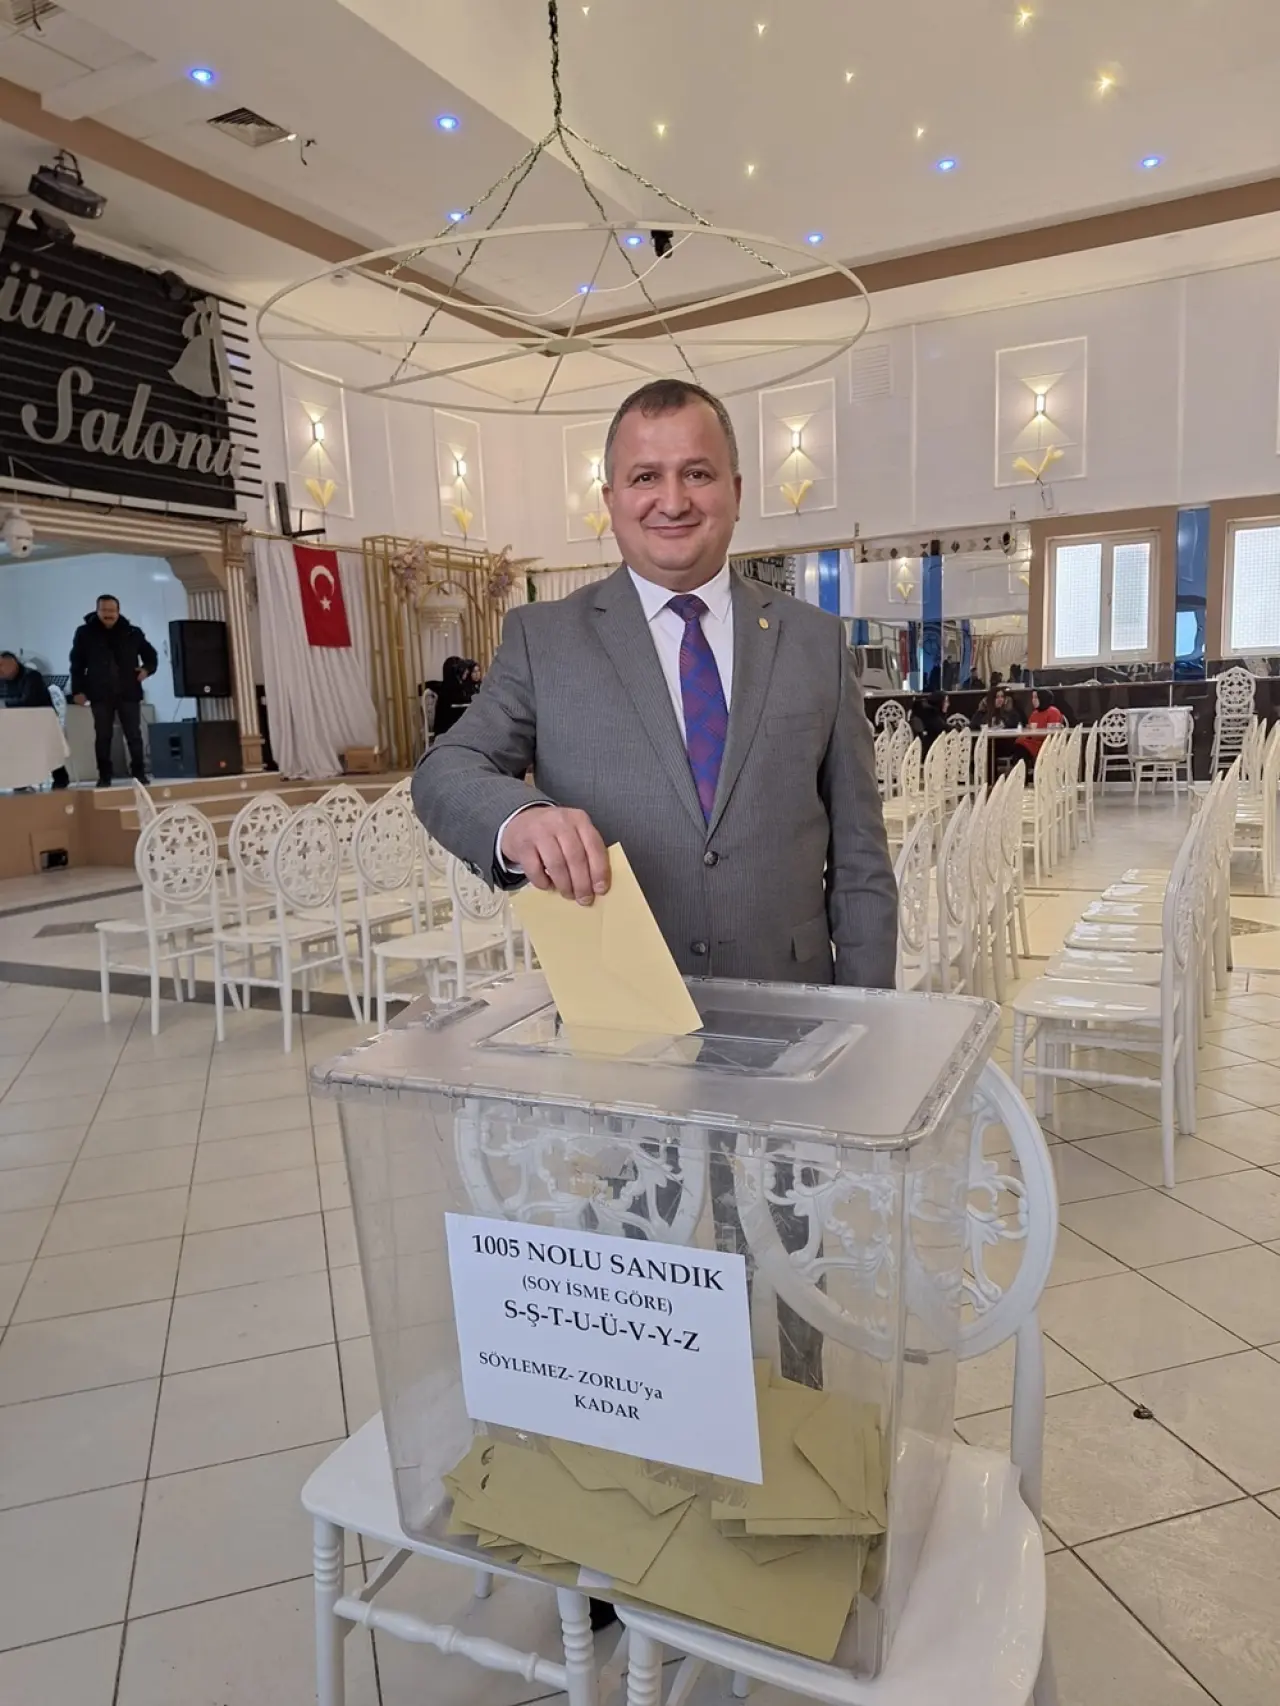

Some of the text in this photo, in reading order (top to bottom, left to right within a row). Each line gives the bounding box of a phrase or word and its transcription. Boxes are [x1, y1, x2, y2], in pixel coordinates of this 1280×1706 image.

[21, 366, 246, 479] Salonu
[472, 1234, 725, 1291] 1005 NOLU SANDIK
[522, 1274, 673, 1316] (SOY İSME GÖRE)
[504, 1299, 700, 1352] S-Ş-T-U-Ü-V-Y-Z
[479, 1351, 574, 1381] SÖYLEMEZ-
[574, 1394, 641, 1420] KADAR
